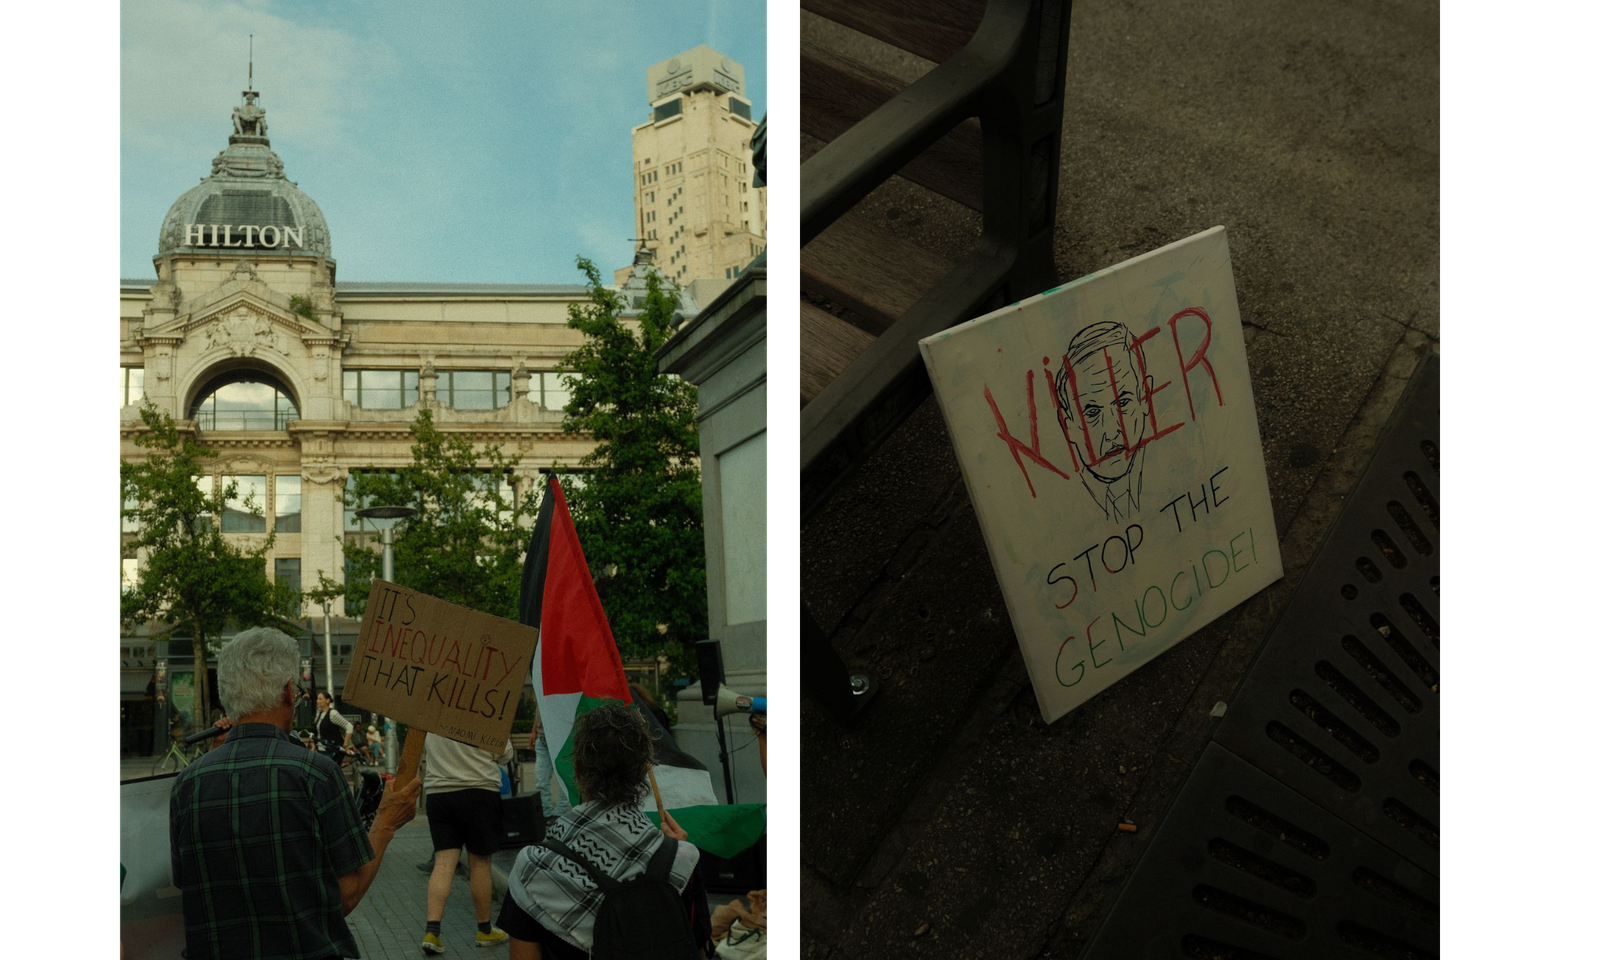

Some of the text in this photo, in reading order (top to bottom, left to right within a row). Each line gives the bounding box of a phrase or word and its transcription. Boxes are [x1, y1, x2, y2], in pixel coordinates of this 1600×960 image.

[183, 223, 306, 248] HILTON
[1047, 466, 1230, 609] STOP THE
[377, 588, 416, 626] IT'S
[363, 655, 511, 721] THAT KILLS!
